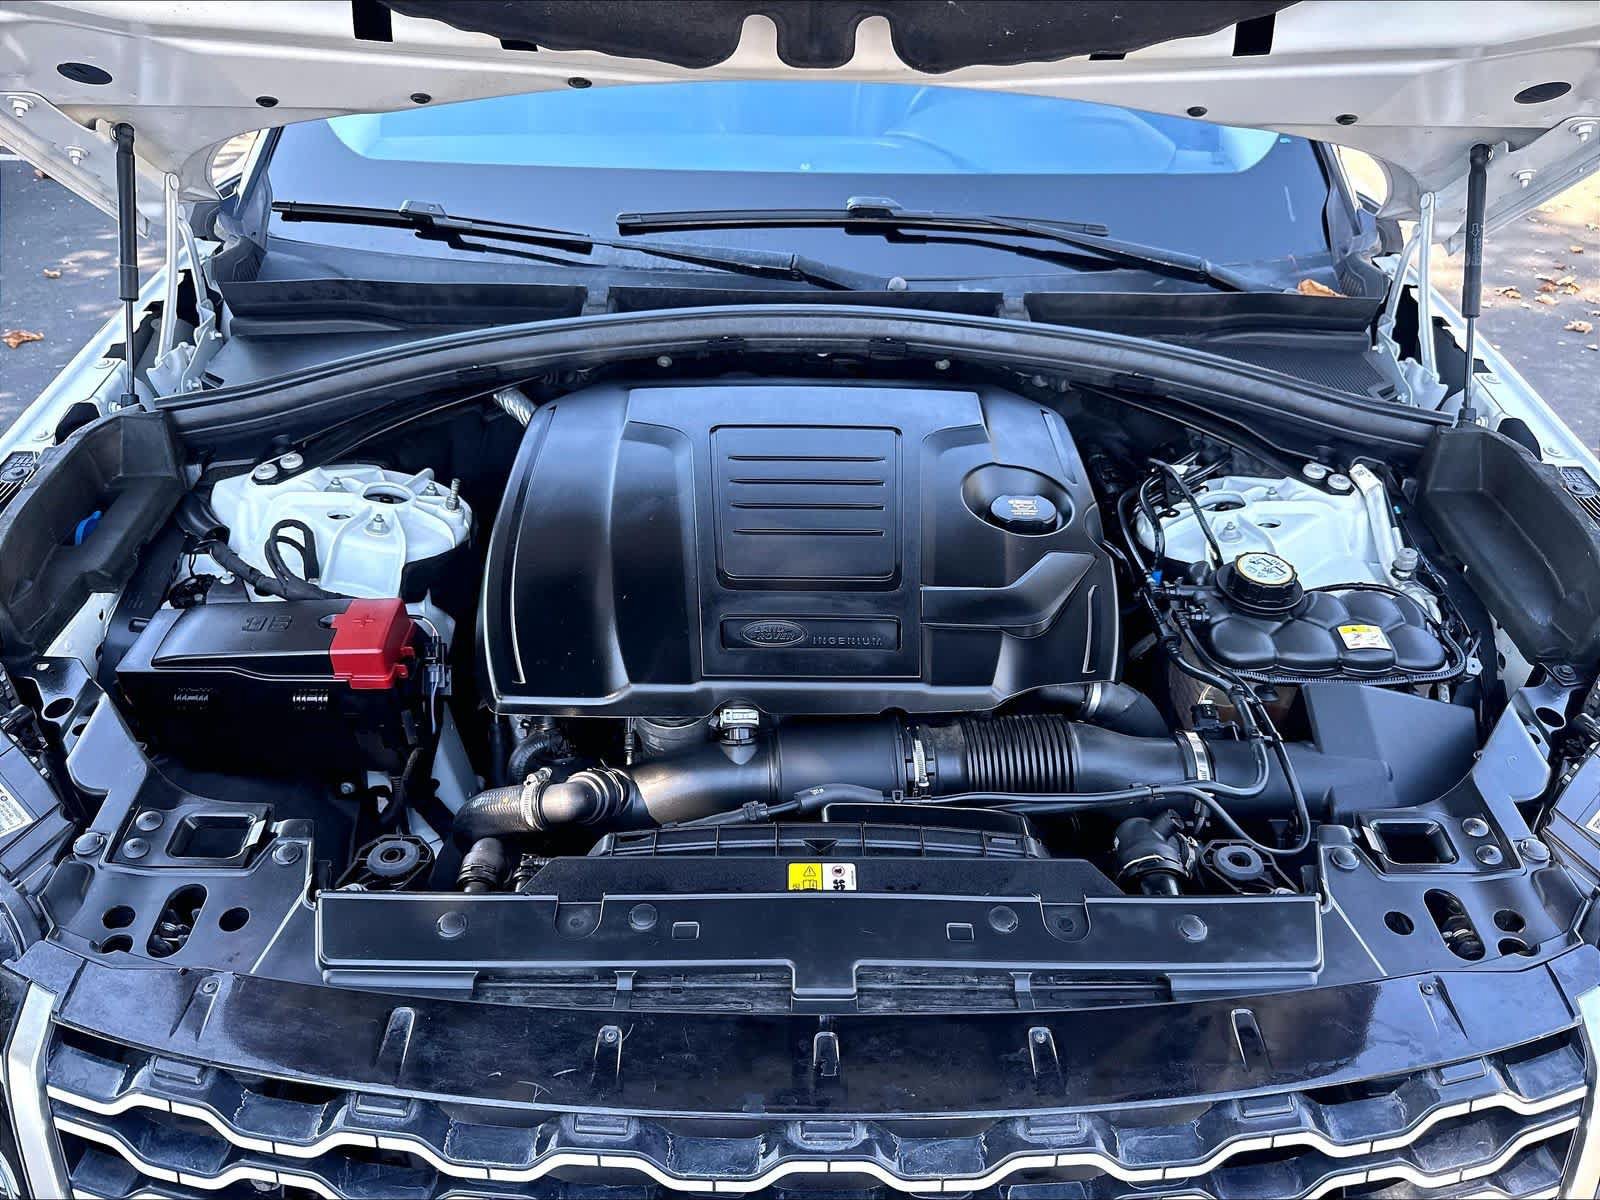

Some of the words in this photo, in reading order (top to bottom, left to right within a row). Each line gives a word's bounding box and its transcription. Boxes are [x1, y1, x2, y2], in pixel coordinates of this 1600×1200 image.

[753, 624, 785, 633] LAND
[754, 632, 796, 640] ROVER
[812, 636, 883, 646] INGENIUM
